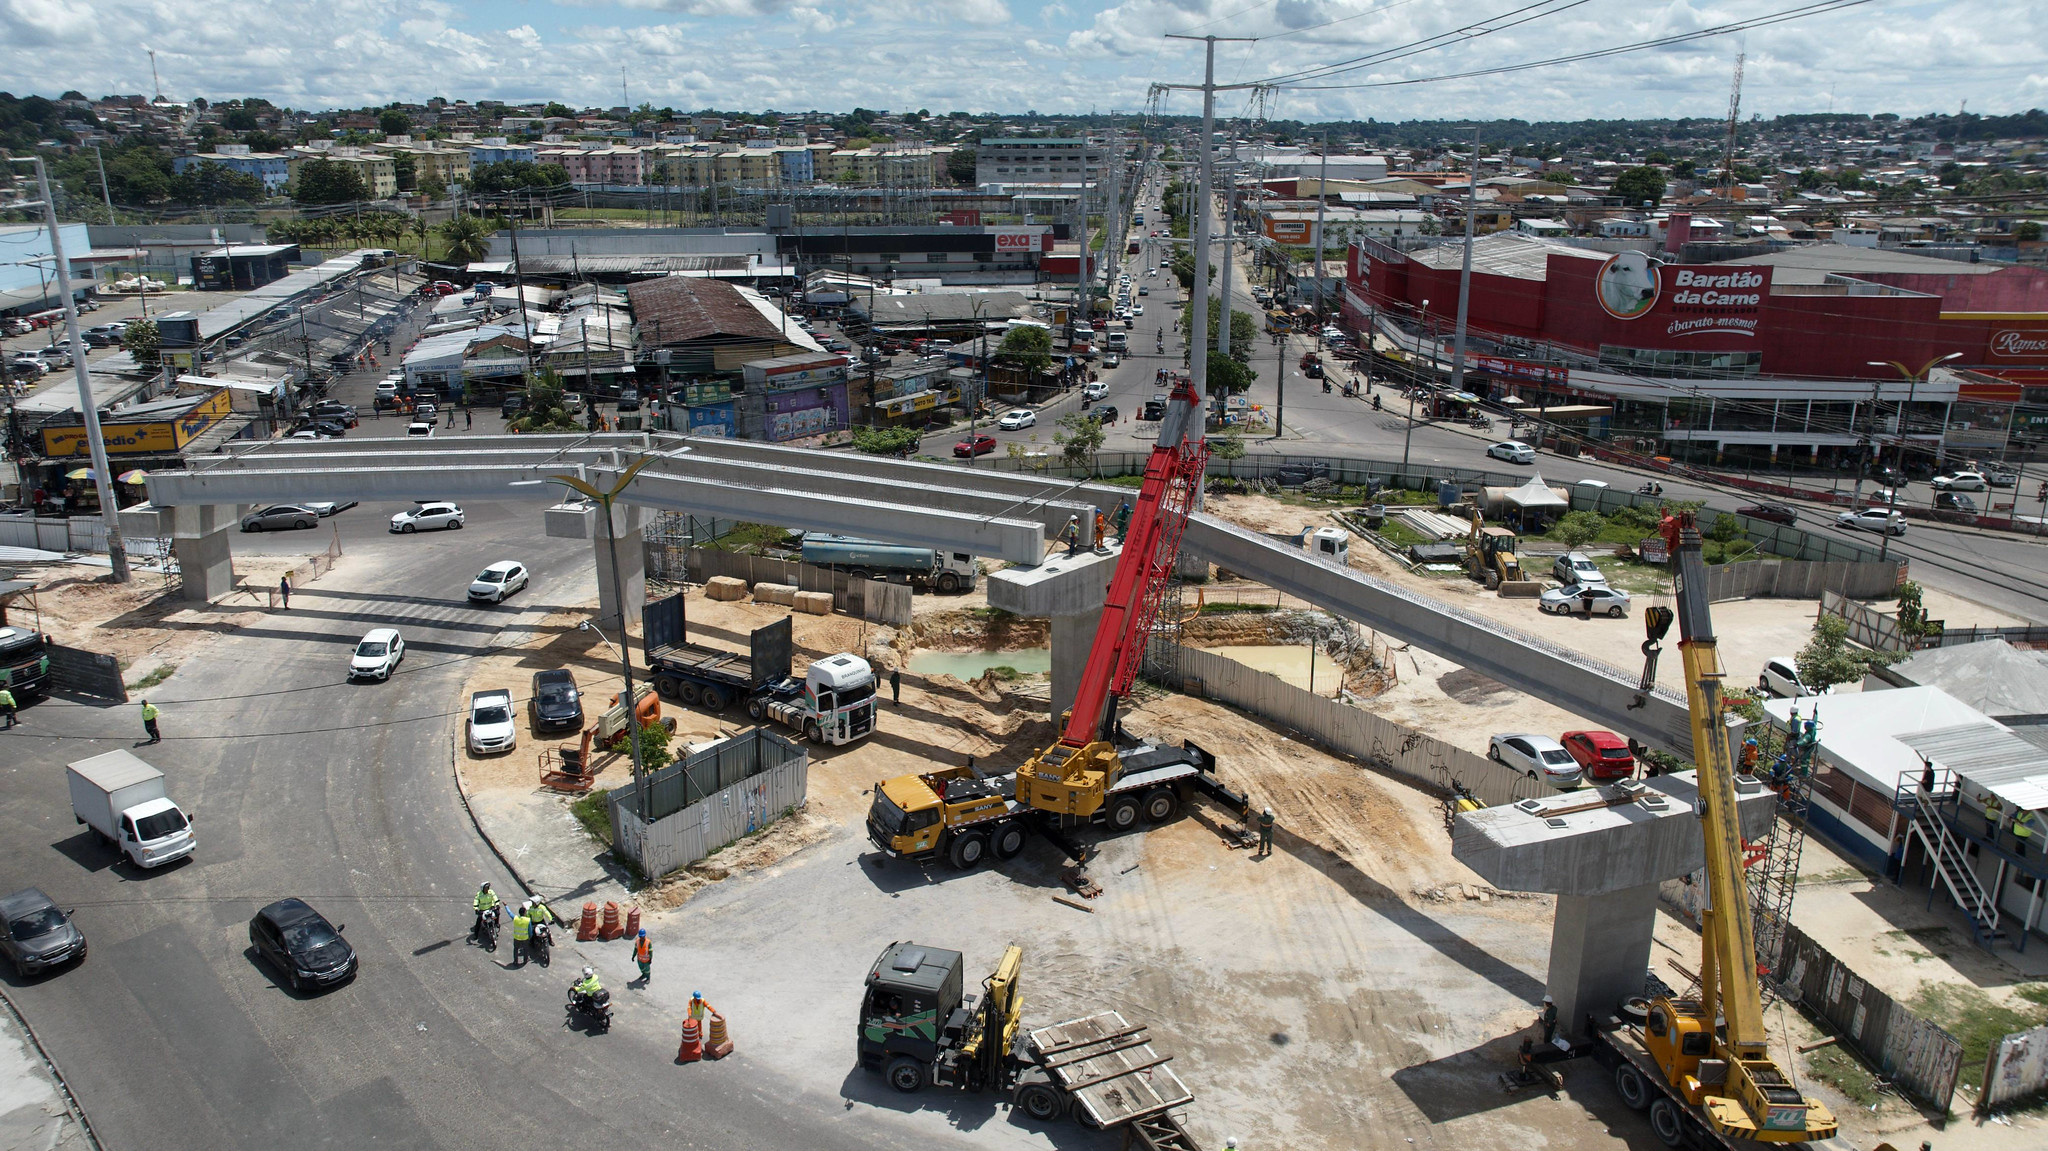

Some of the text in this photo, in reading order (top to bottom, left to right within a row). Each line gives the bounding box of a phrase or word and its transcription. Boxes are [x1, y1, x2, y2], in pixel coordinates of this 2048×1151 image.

[997, 234, 1030, 247] exa
[1675, 270, 1763, 288] Baratão
[1672, 306, 1758, 314] SUPERMERCADOS
[1717, 317, 1757, 331] mesmo!
[1996, 333, 2048, 354] Rams
[1038, 771, 1061, 782] SANY
[974, 803, 994, 812] SANY
